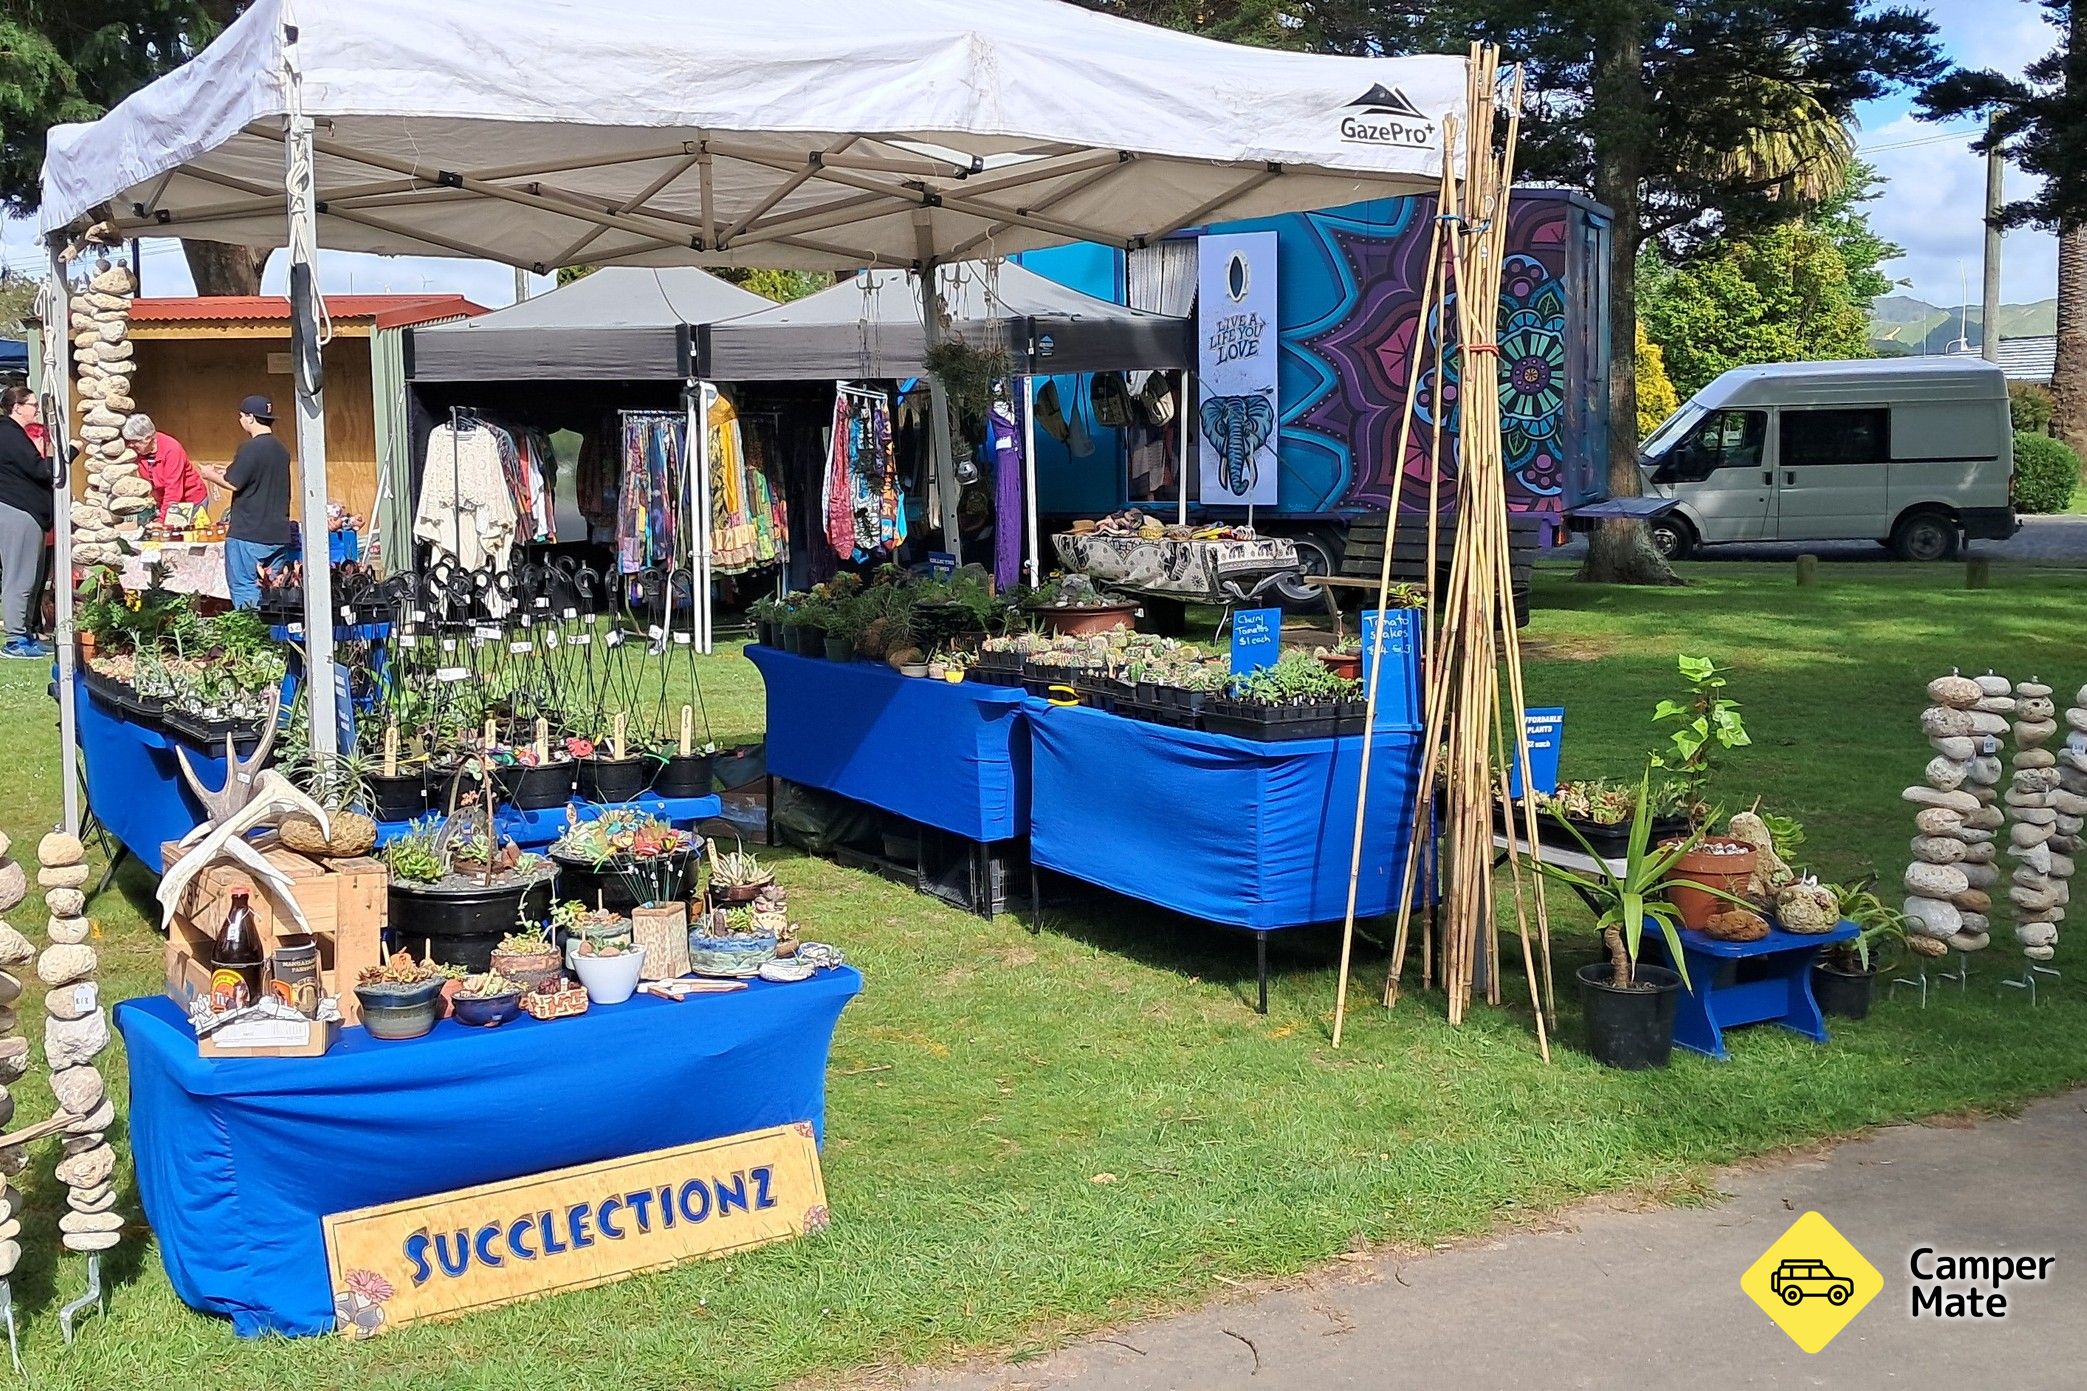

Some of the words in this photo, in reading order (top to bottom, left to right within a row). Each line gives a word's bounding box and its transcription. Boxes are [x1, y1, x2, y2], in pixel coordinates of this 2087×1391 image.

[1216, 315, 1247, 334] LIVE
[1249, 313, 1258, 326] A
[1208, 329, 1237, 351] LIFE
[1238, 325, 1264, 340] YOU
[1214, 340, 1260, 366] LOVE
[1363, 613, 1410, 628] Tmato
[1251, 634, 1272, 645] each
[1527, 725, 1553, 734] PLANTS
[402, 1164, 779, 1288] SUCCLECTIONZ
